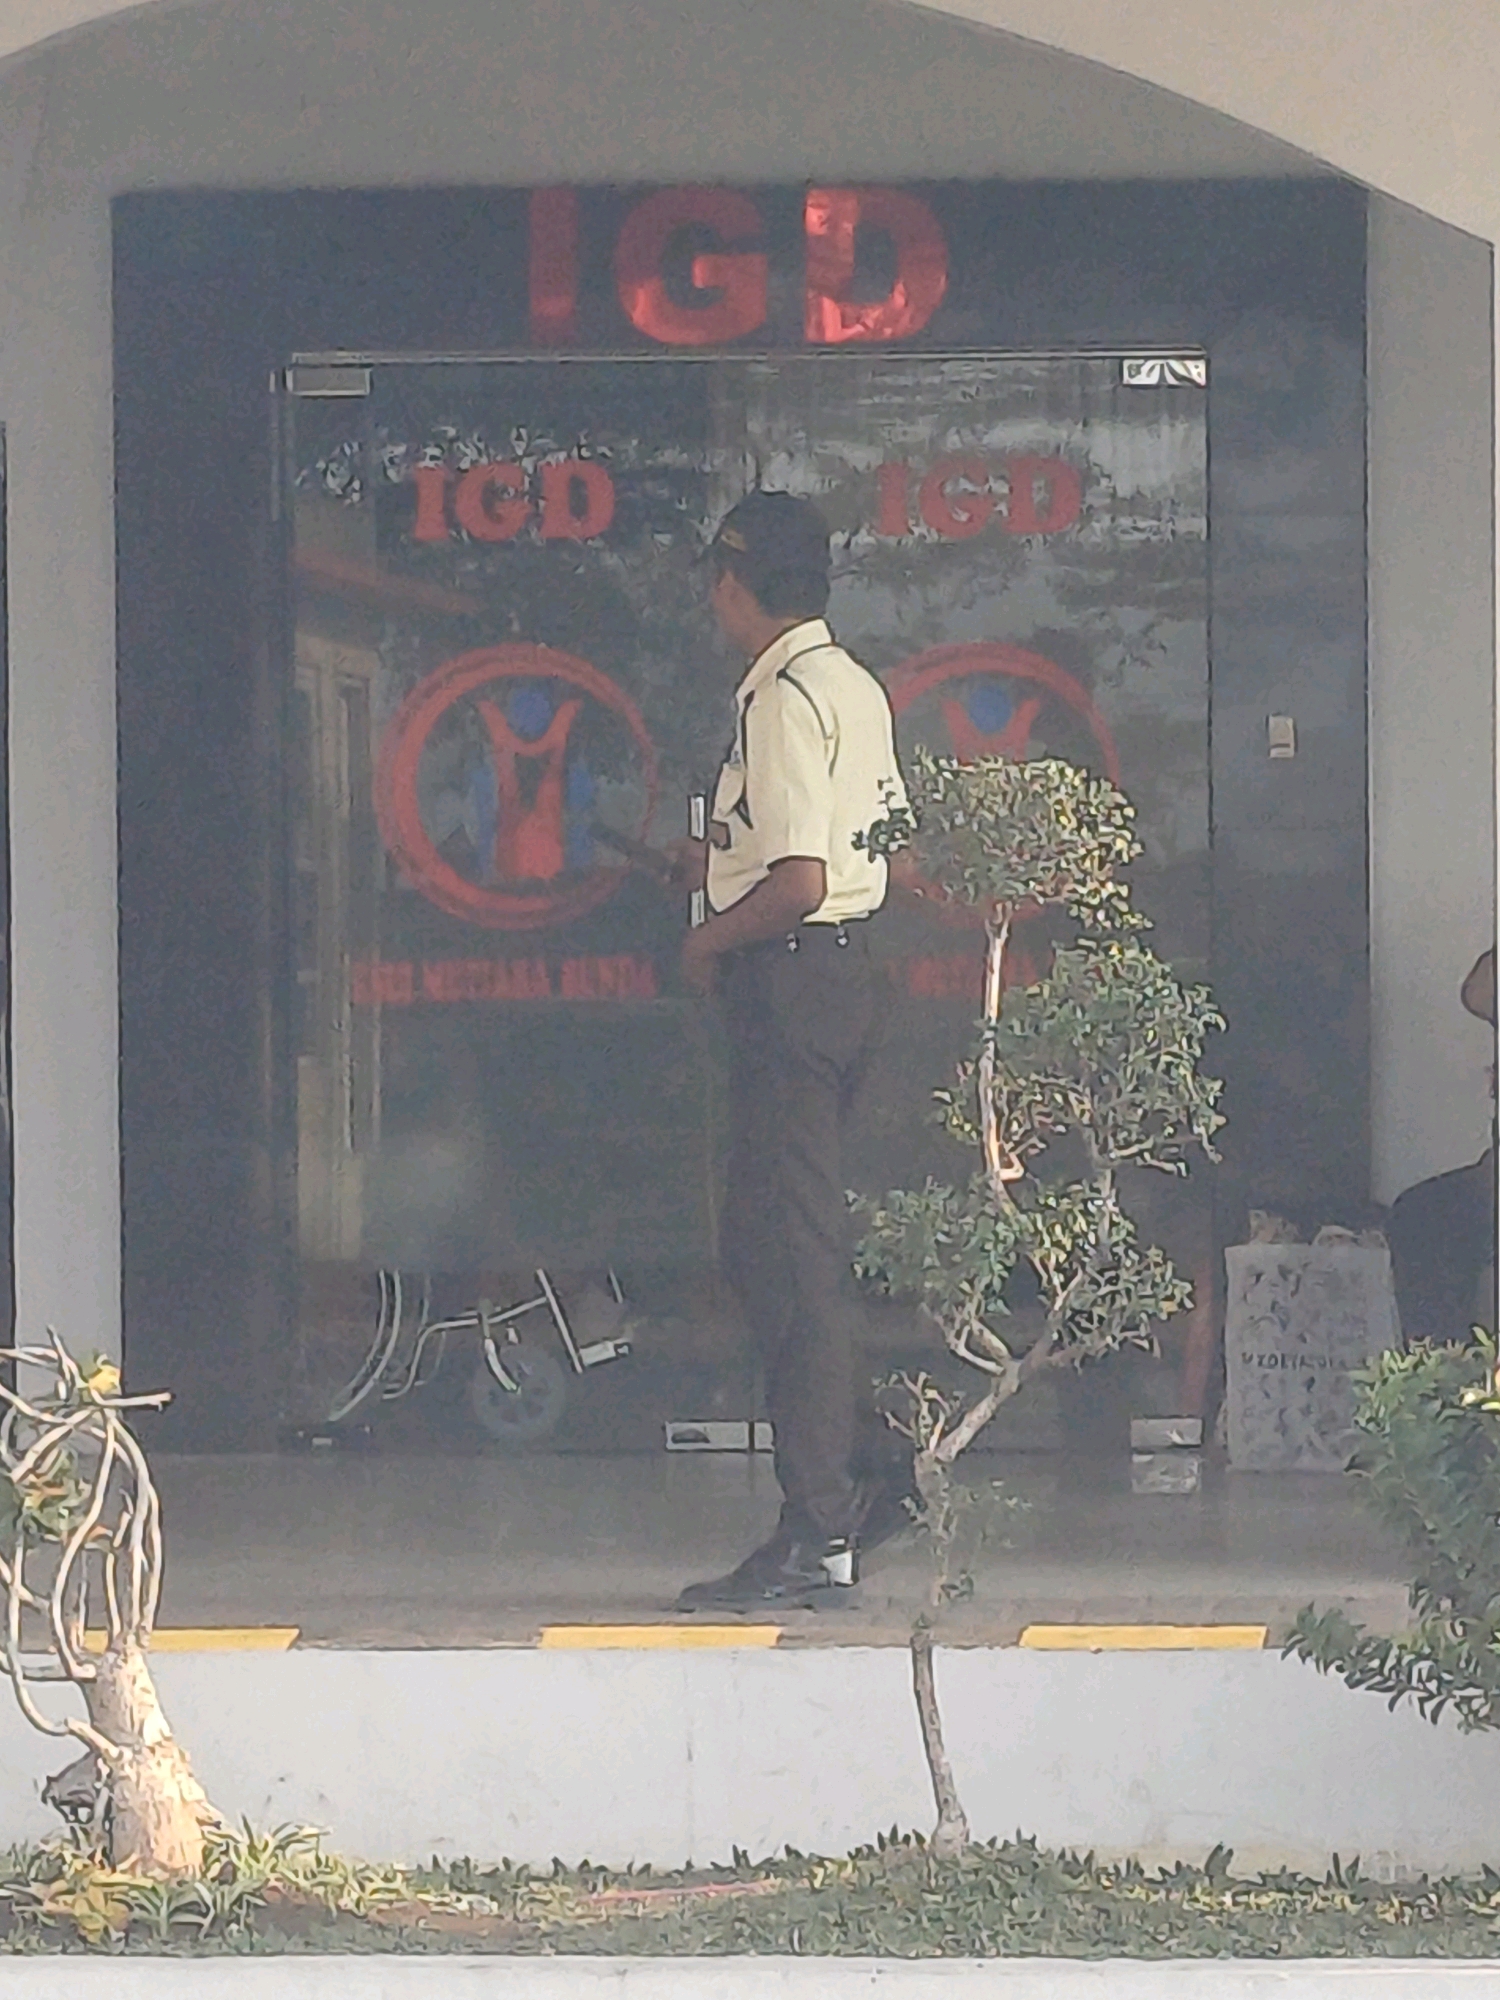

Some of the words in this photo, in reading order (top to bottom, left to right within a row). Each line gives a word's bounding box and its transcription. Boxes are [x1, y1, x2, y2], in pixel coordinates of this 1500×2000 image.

[529, 185, 949, 346] IGD
[413, 458, 615, 542] IGD
[873, 452, 1083, 538] IGD
